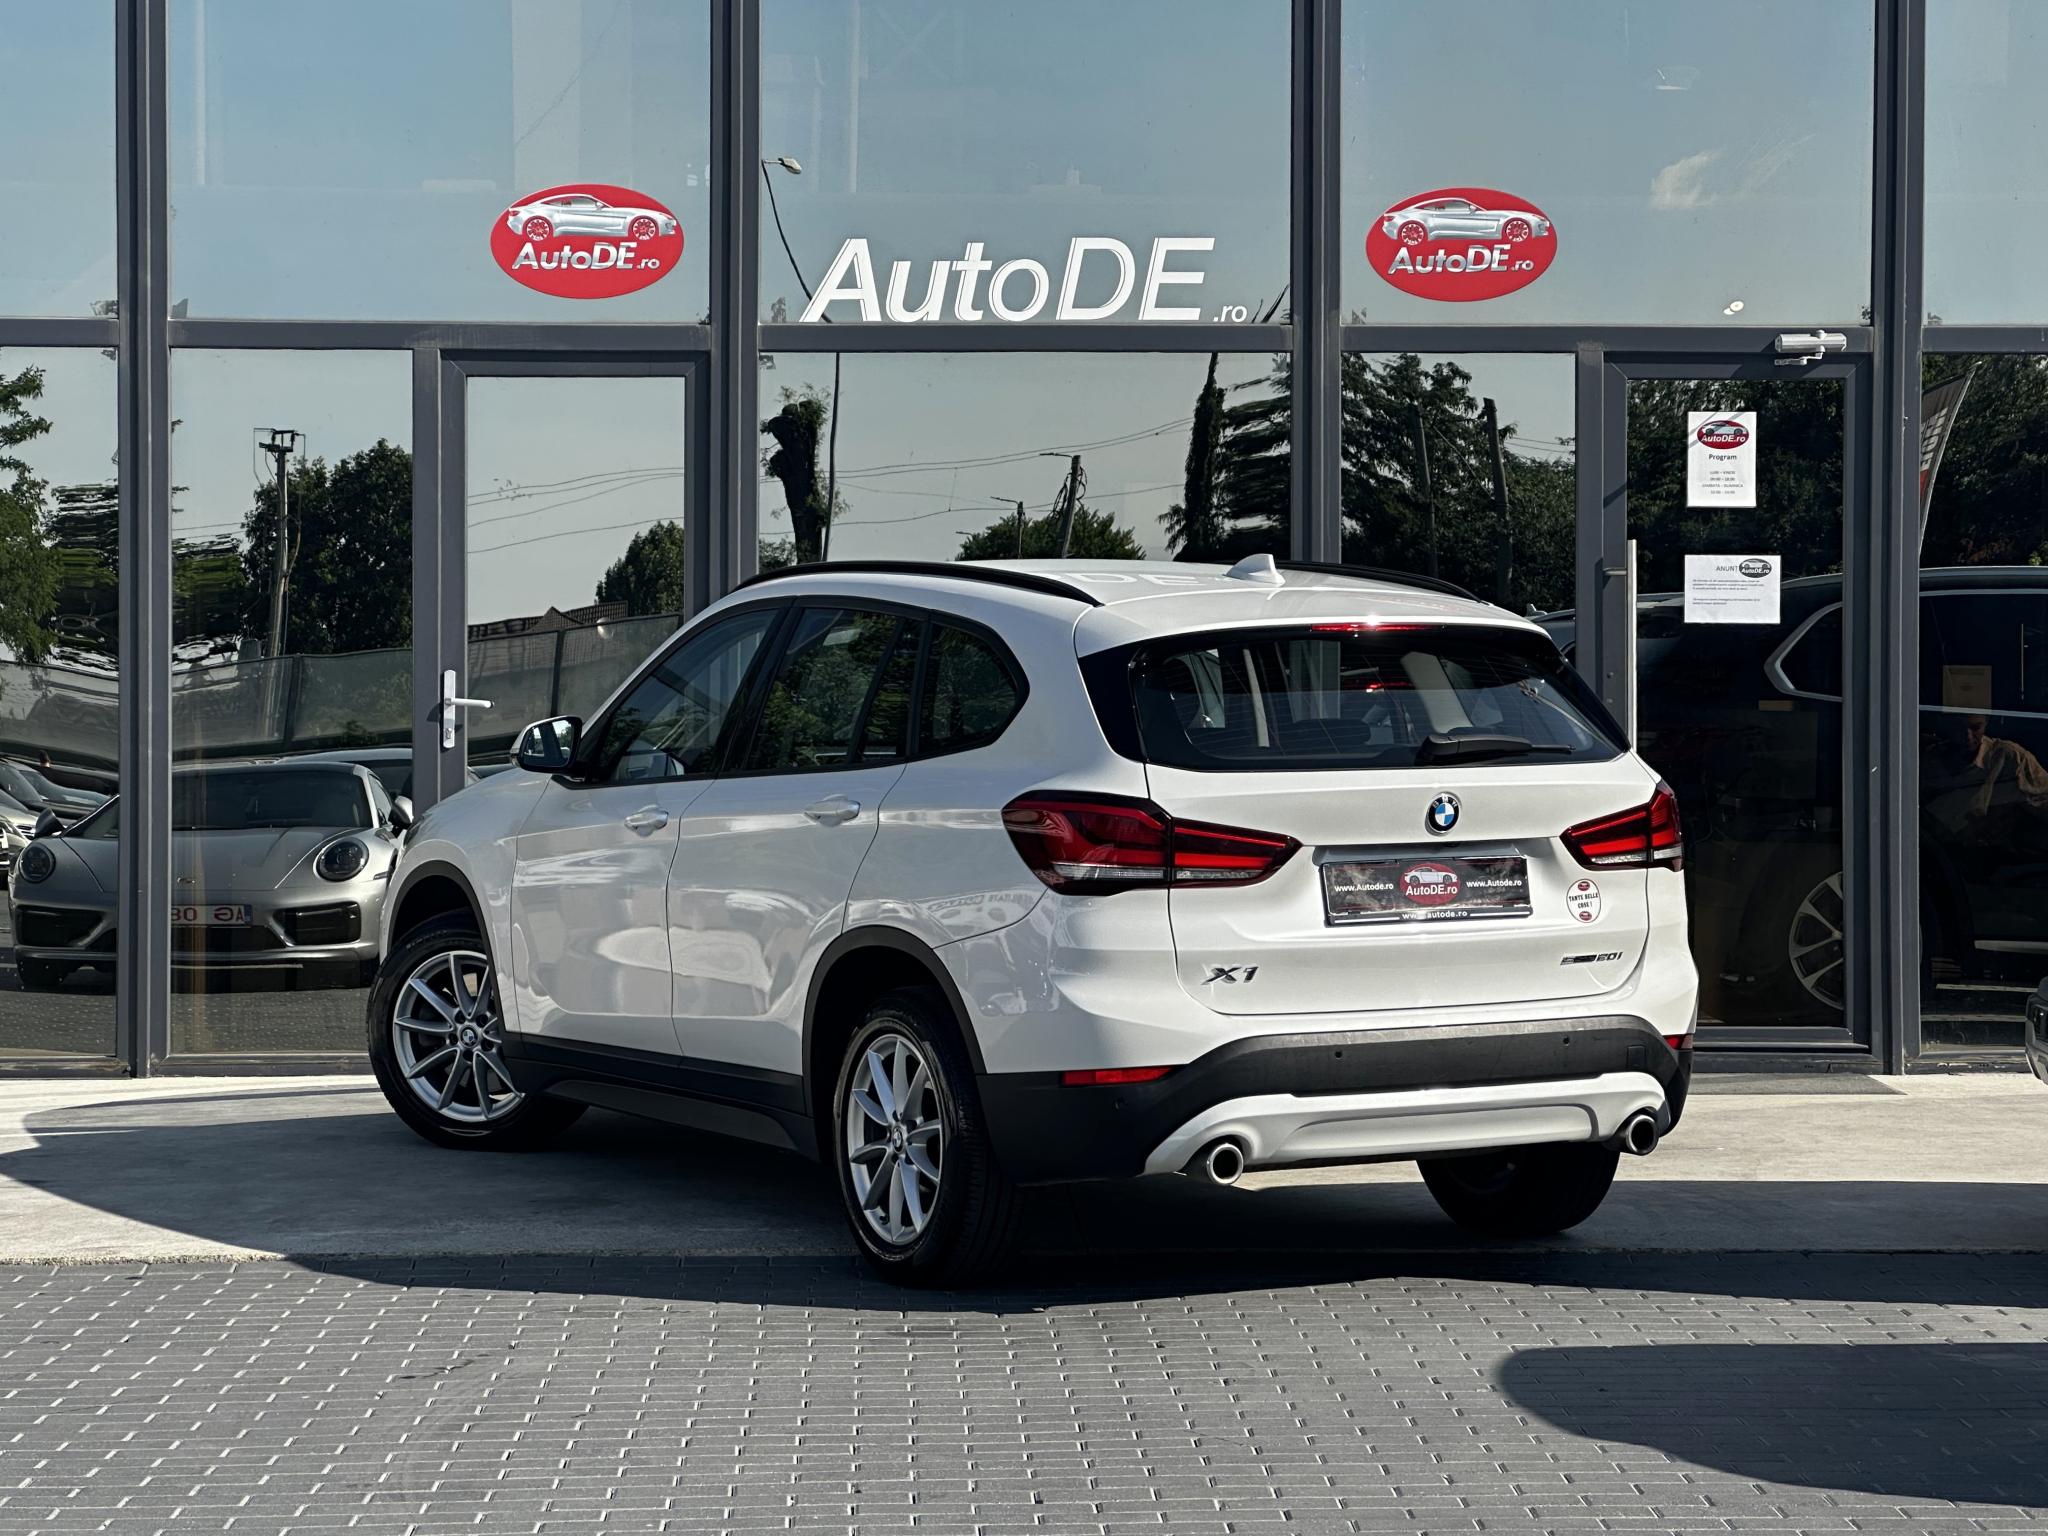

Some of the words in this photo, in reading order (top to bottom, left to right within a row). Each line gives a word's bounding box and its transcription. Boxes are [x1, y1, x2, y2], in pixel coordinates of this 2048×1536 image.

[1701, 434, 1746, 443] AutoDE.ro
[1708, 453, 1737, 462] Program
[1334, 882, 1394, 892] www.Autode.ro
[1466, 879, 1522, 888] www.Autode.ro
[1405, 884, 1458, 896] AutoDE.ro
[1201, 966, 1259, 985] X1
